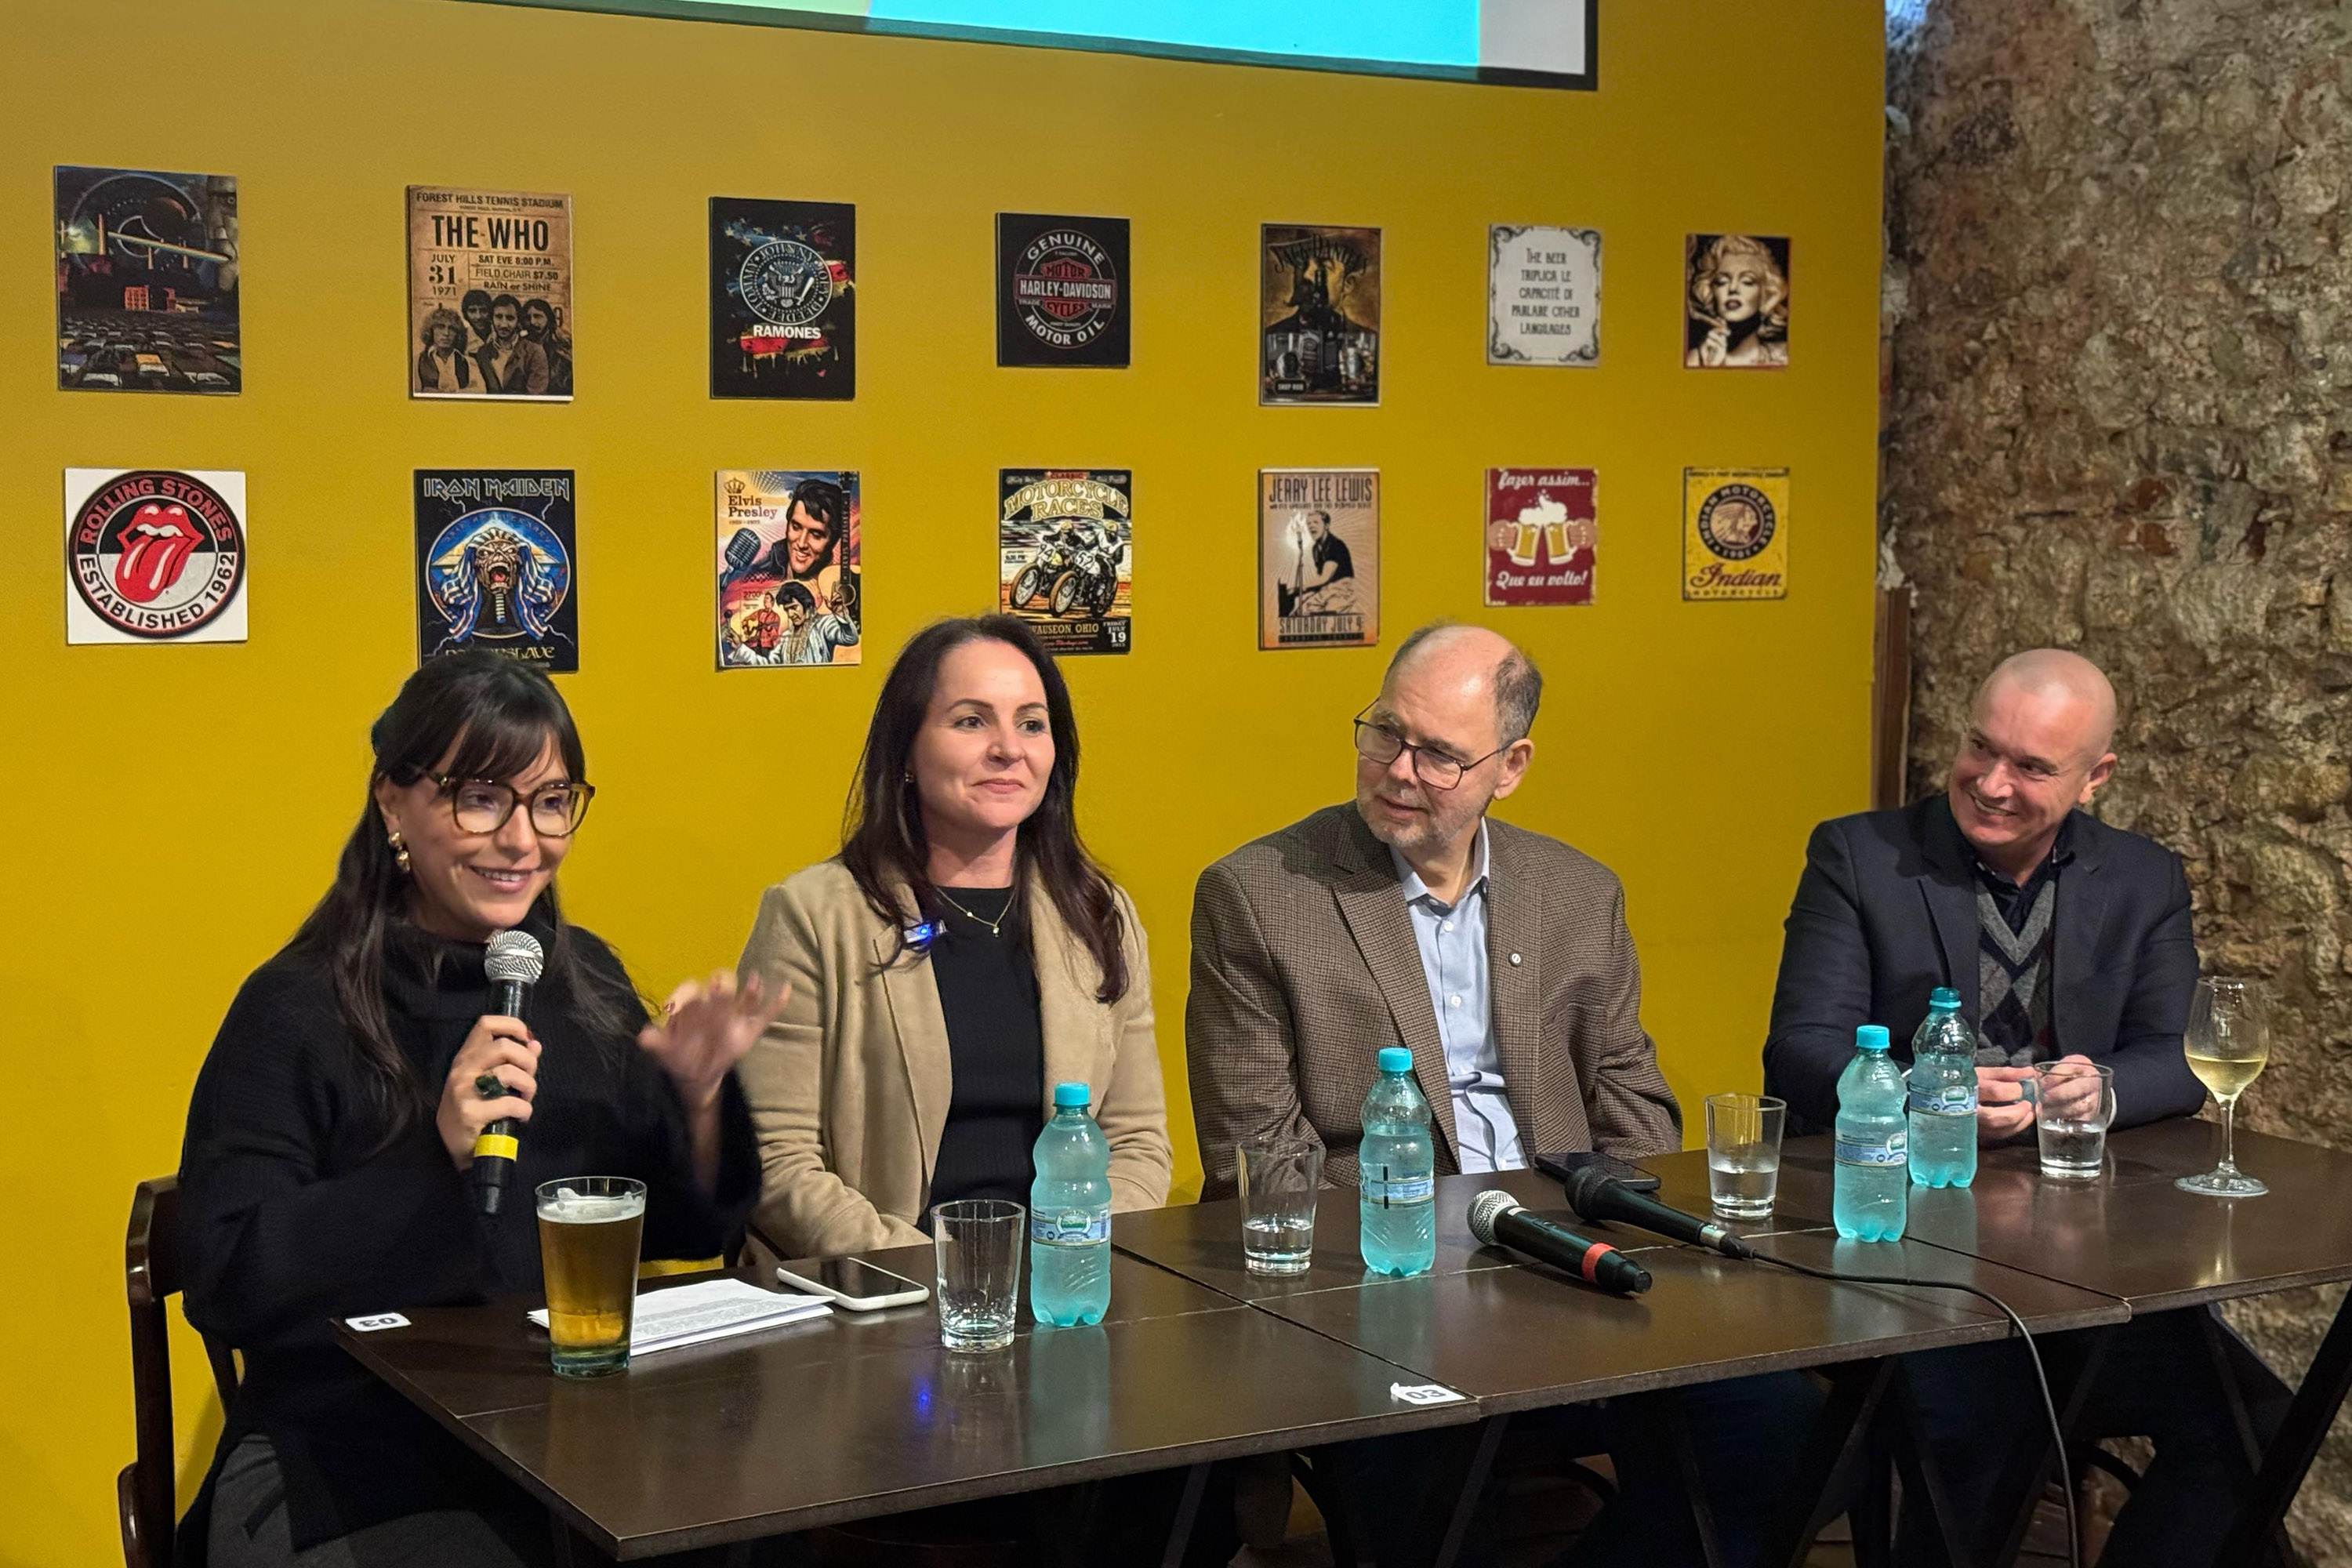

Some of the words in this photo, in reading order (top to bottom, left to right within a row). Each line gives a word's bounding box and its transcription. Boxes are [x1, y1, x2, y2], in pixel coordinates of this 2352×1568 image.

[416, 192, 453, 202] FOREST
[456, 194, 483, 205] HILLS
[485, 195, 519, 207] TENNIS
[521, 198, 564, 209] STADIUM
[431, 216, 479, 249] THE
[487, 217, 549, 252] WHO
[1027, 233, 1106, 266] GENUINE
[431, 254, 456, 263] JULY
[478, 255, 495, 264] SAT
[497, 255, 513, 265] EVE
[1545, 252, 1566, 265] BEER
[429, 264, 456, 285] 31
[475, 268, 501, 278] FIELD
[503, 269, 532, 279] CHAIR
[533, 270, 558, 281] $7.50
[1046, 262, 1086, 278] MOTOR
[1521, 269, 1557, 282] TRIPLICA
[1561, 270, 1571, 282] LE
[432, 285, 457, 296] 1971
[484, 281, 508, 291] RAIN
[522, 283, 552, 292] SHINE
[1019, 279, 1112, 299] HARLEY-DAVIDSON
[1047, 301, 1086, 318] CYCLES
[1552, 306, 1581, 318] OTHER
[753, 324, 822, 340] RAMONES
[1025, 314, 1072, 346] MOTOR
[1076, 319, 1105, 343] OIL
[1520, 322, 1572, 336] LANGUAGES
[1498, 472, 1535, 490] fazer
[423, 477, 480, 502] IRON
[483, 477, 570, 503] MAIDEN
[1269, 477, 1308, 503] JERRY
[1312, 477, 1331, 502] LEE
[1336, 477, 1373, 502] LEWIS
[728, 495, 763, 506] Elvis
[1005, 479, 1129, 521] MOTORCYCLE
[80, 478, 156, 546] ROLLING
[161, 479, 234, 543] STONES
[728, 506, 779, 520] Presley
[1031, 498, 1104, 523] RACES
[1496, 571, 1525, 590] Que
[1527, 575, 1544, 586] eu
[1547, 570, 1588, 586] volto!
[1690, 562, 1782, 589] Indian
[79, 556, 205, 630] ESTABLISHED
[205, 554, 235, 604] 1962
[1075, 623, 1099, 633] OHIO
[1279, 617, 1328, 633] SATURDAY
[1331, 616, 1353, 632] JULY
[1110, 632, 1127, 643] 19
[358, 1317, 398, 1327] 03
[1405, 1389, 1446, 1399] 03
